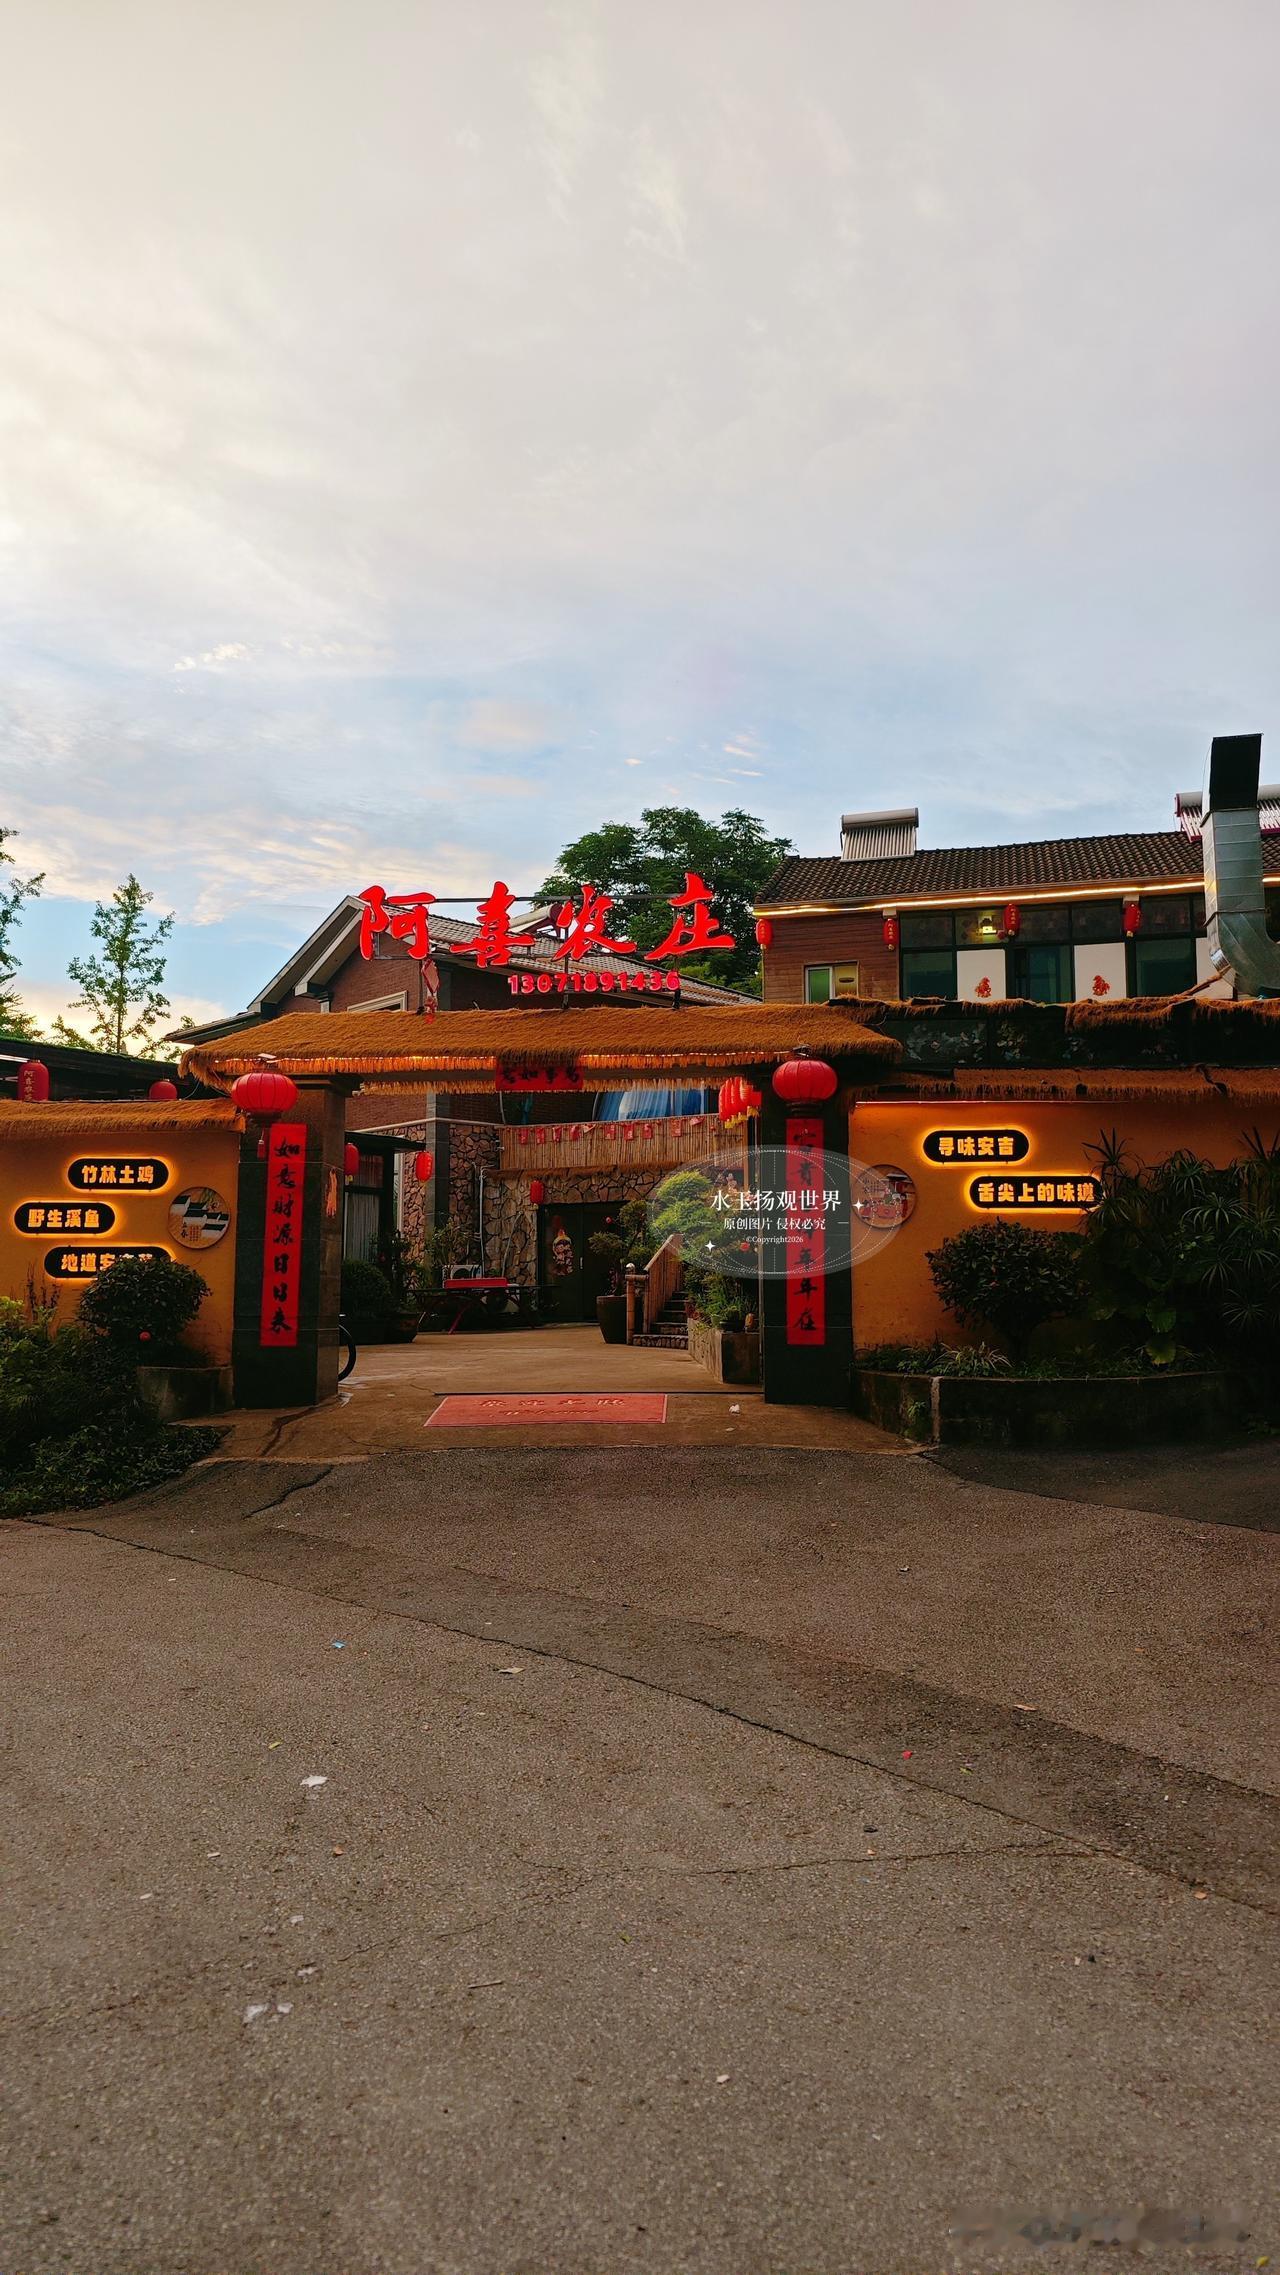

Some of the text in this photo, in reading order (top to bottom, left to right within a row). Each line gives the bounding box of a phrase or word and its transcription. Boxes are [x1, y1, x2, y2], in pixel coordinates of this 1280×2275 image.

[358, 872, 737, 968] 阿喜农庄
[507, 970, 681, 994] 13071891436
[938, 1137, 1014, 1156] 寻味安吉
[81, 1165, 154, 1184] 竹林土鸡
[978, 1182, 1095, 1202] 舌尖上的味道
[27, 1209, 100, 1228] 野生溪鱼
[269, 1136, 301, 1333] 如意财源日日来
[61, 1253, 153, 1272] 地道安
